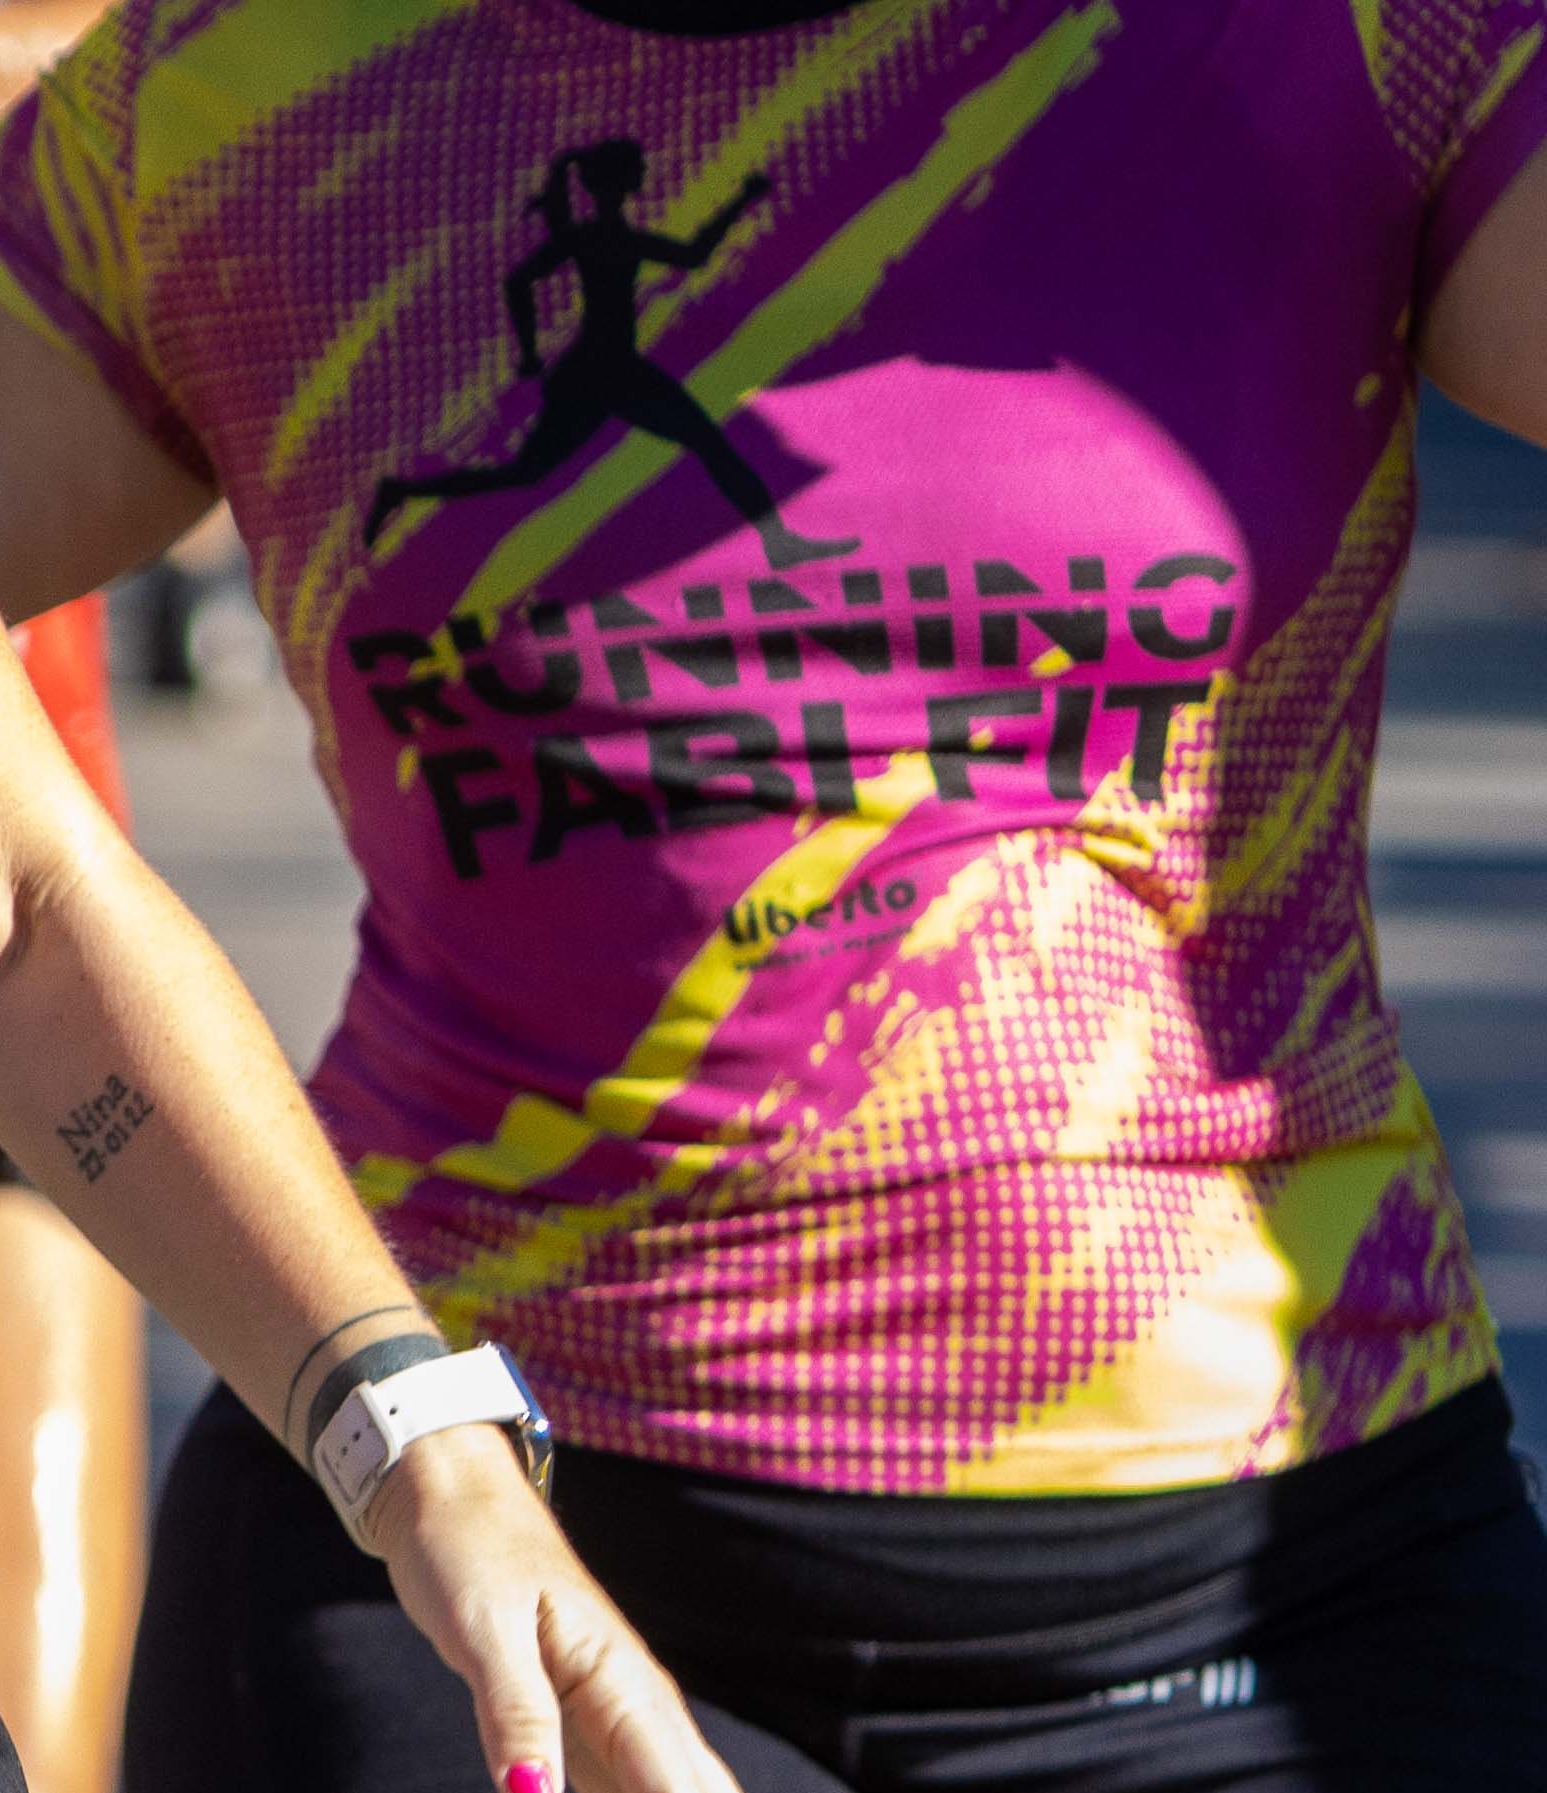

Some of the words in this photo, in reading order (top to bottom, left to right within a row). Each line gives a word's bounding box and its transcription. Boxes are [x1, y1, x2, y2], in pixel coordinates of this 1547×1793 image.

[348, 554, 1237, 736] RUNNING
[422, 704, 858, 880] FABI
[926, 683, 1210, 801] FIT
